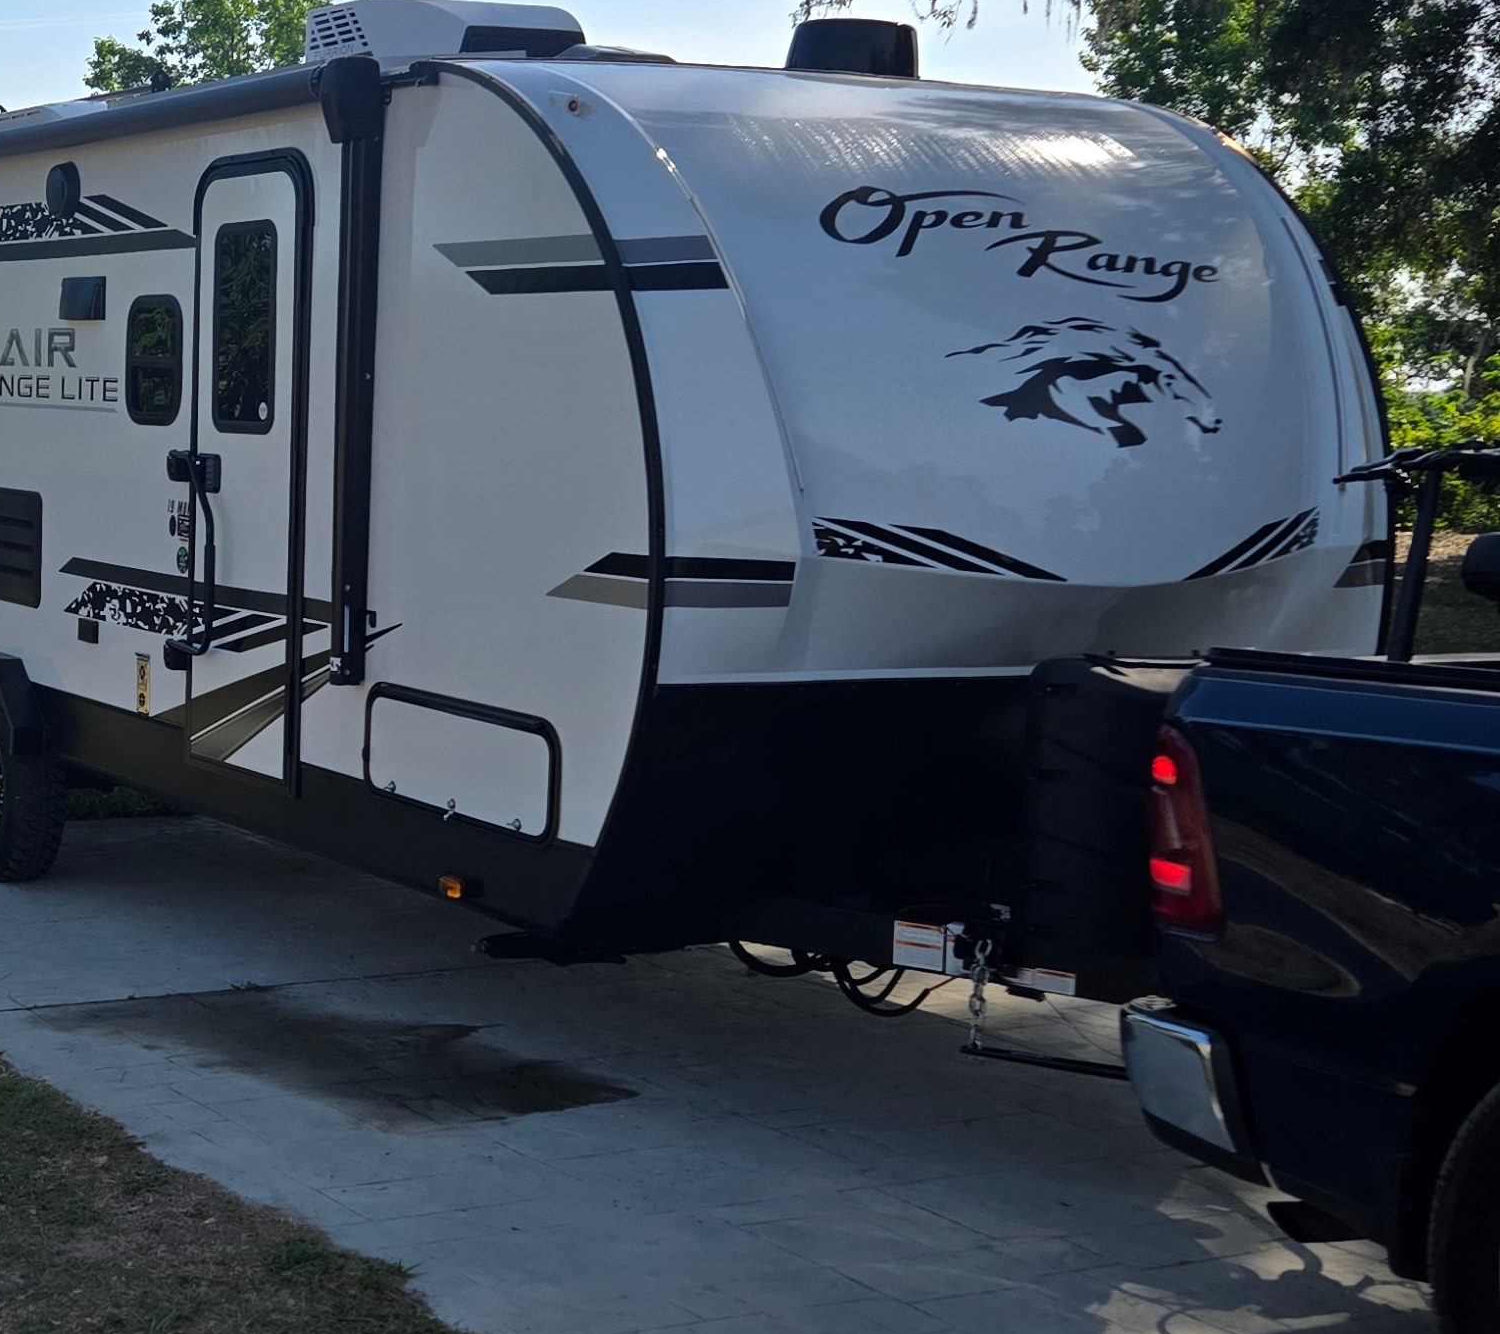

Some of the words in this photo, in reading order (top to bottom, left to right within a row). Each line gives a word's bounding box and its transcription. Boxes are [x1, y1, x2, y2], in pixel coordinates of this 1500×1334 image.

[819, 185, 1030, 258] Open
[984, 230, 1220, 304] Range
[61, 375, 119, 403] LITE
